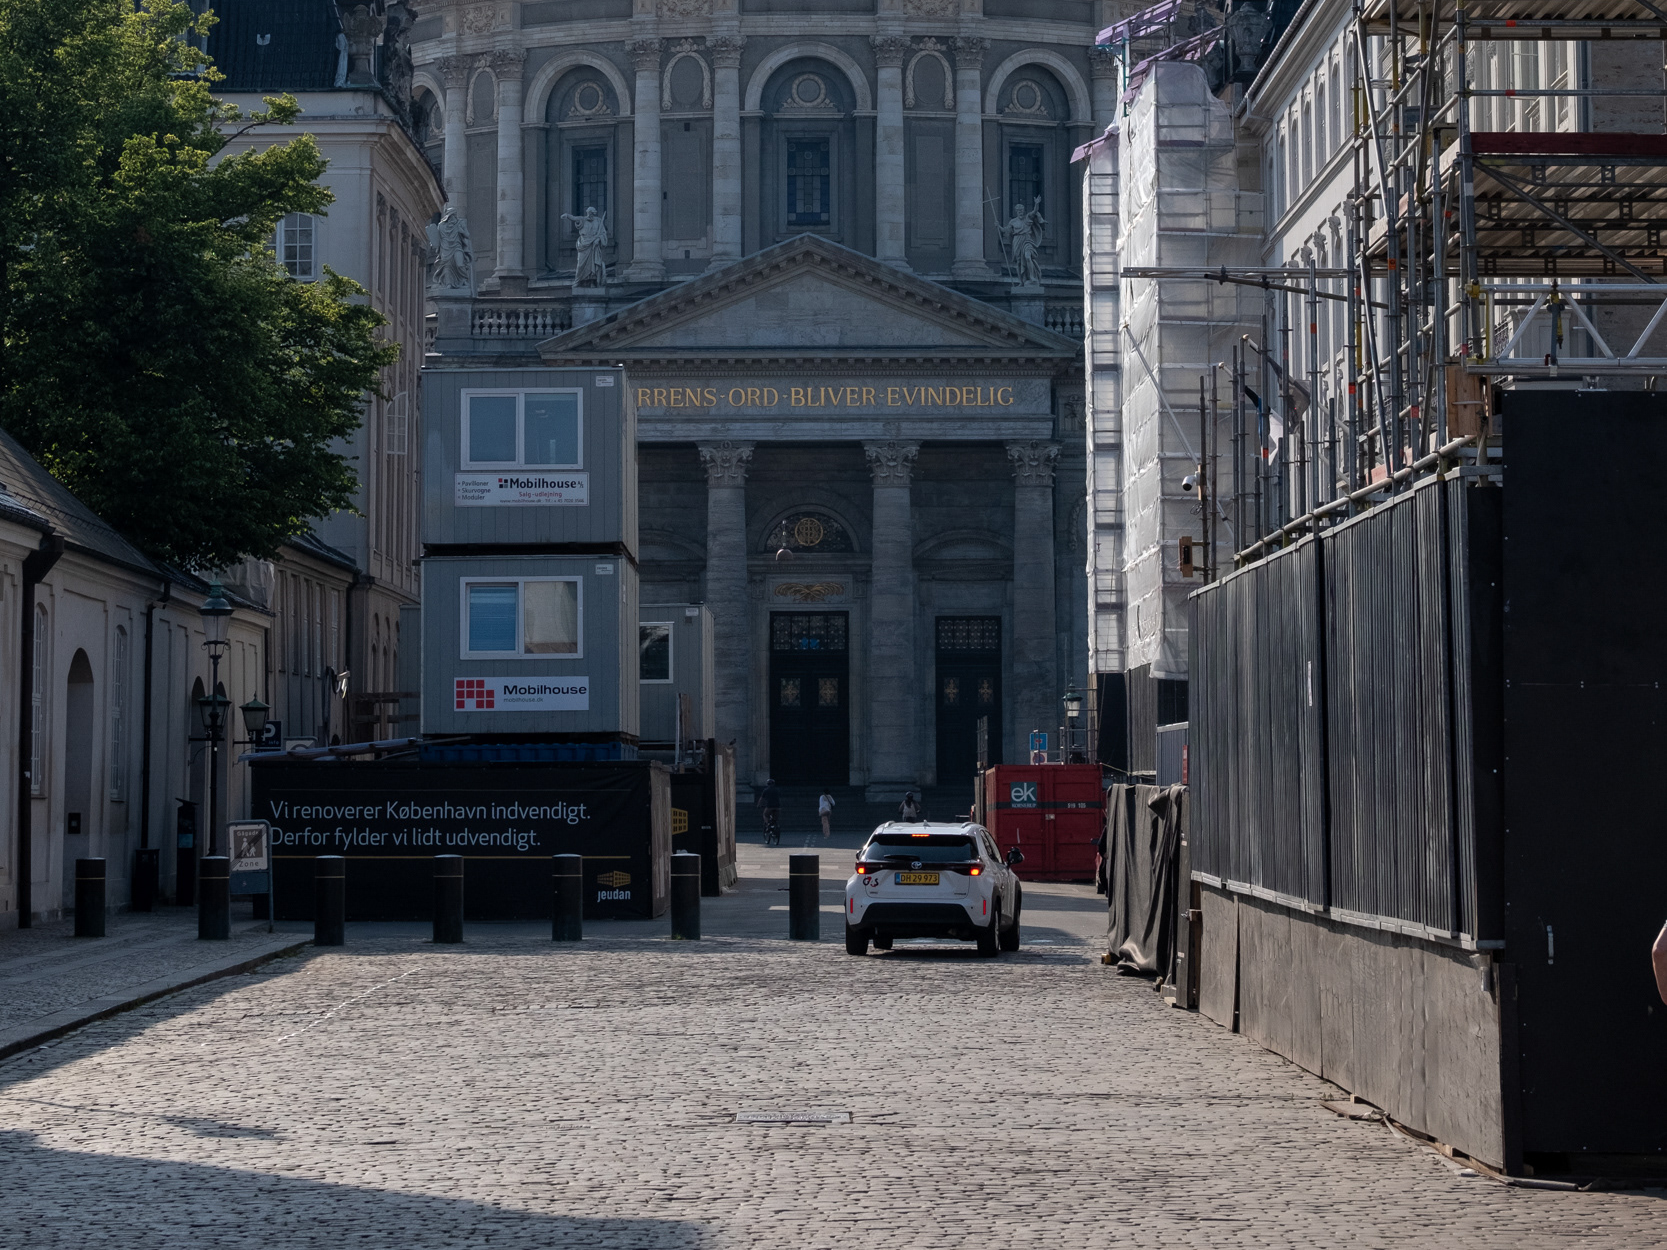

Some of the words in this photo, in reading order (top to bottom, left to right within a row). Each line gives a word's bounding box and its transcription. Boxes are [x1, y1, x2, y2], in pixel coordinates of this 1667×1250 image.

[632, 388, 717, 407] RRENS
[728, 387, 778, 407] ORD
[790, 386, 876, 407] BLIVER
[887, 386, 1014, 406] EVINDELIG
[510, 478, 577, 489] Mobilhouse
[503, 685, 587, 695] Mobilhouse
[1011, 782, 1036, 802] ek
[270, 800, 289, 819] Vi
[293, 806, 382, 819] renoverer
[387, 801, 487, 819] København
[491, 801, 591, 825] indvendigt.
[271, 827, 330, 845] Derfor
[334, 827, 389, 851] fylder
[393, 829, 408, 845] vi
[413, 828, 442, 845] lidt
[446, 828, 541, 851] udvendigt.
[240, 860, 259, 868] Zone
[900, 874, 911, 882] DH
[912, 874, 922, 882] 29
[923, 874, 938, 882] 973
[597, 888, 631, 903] jeudan
